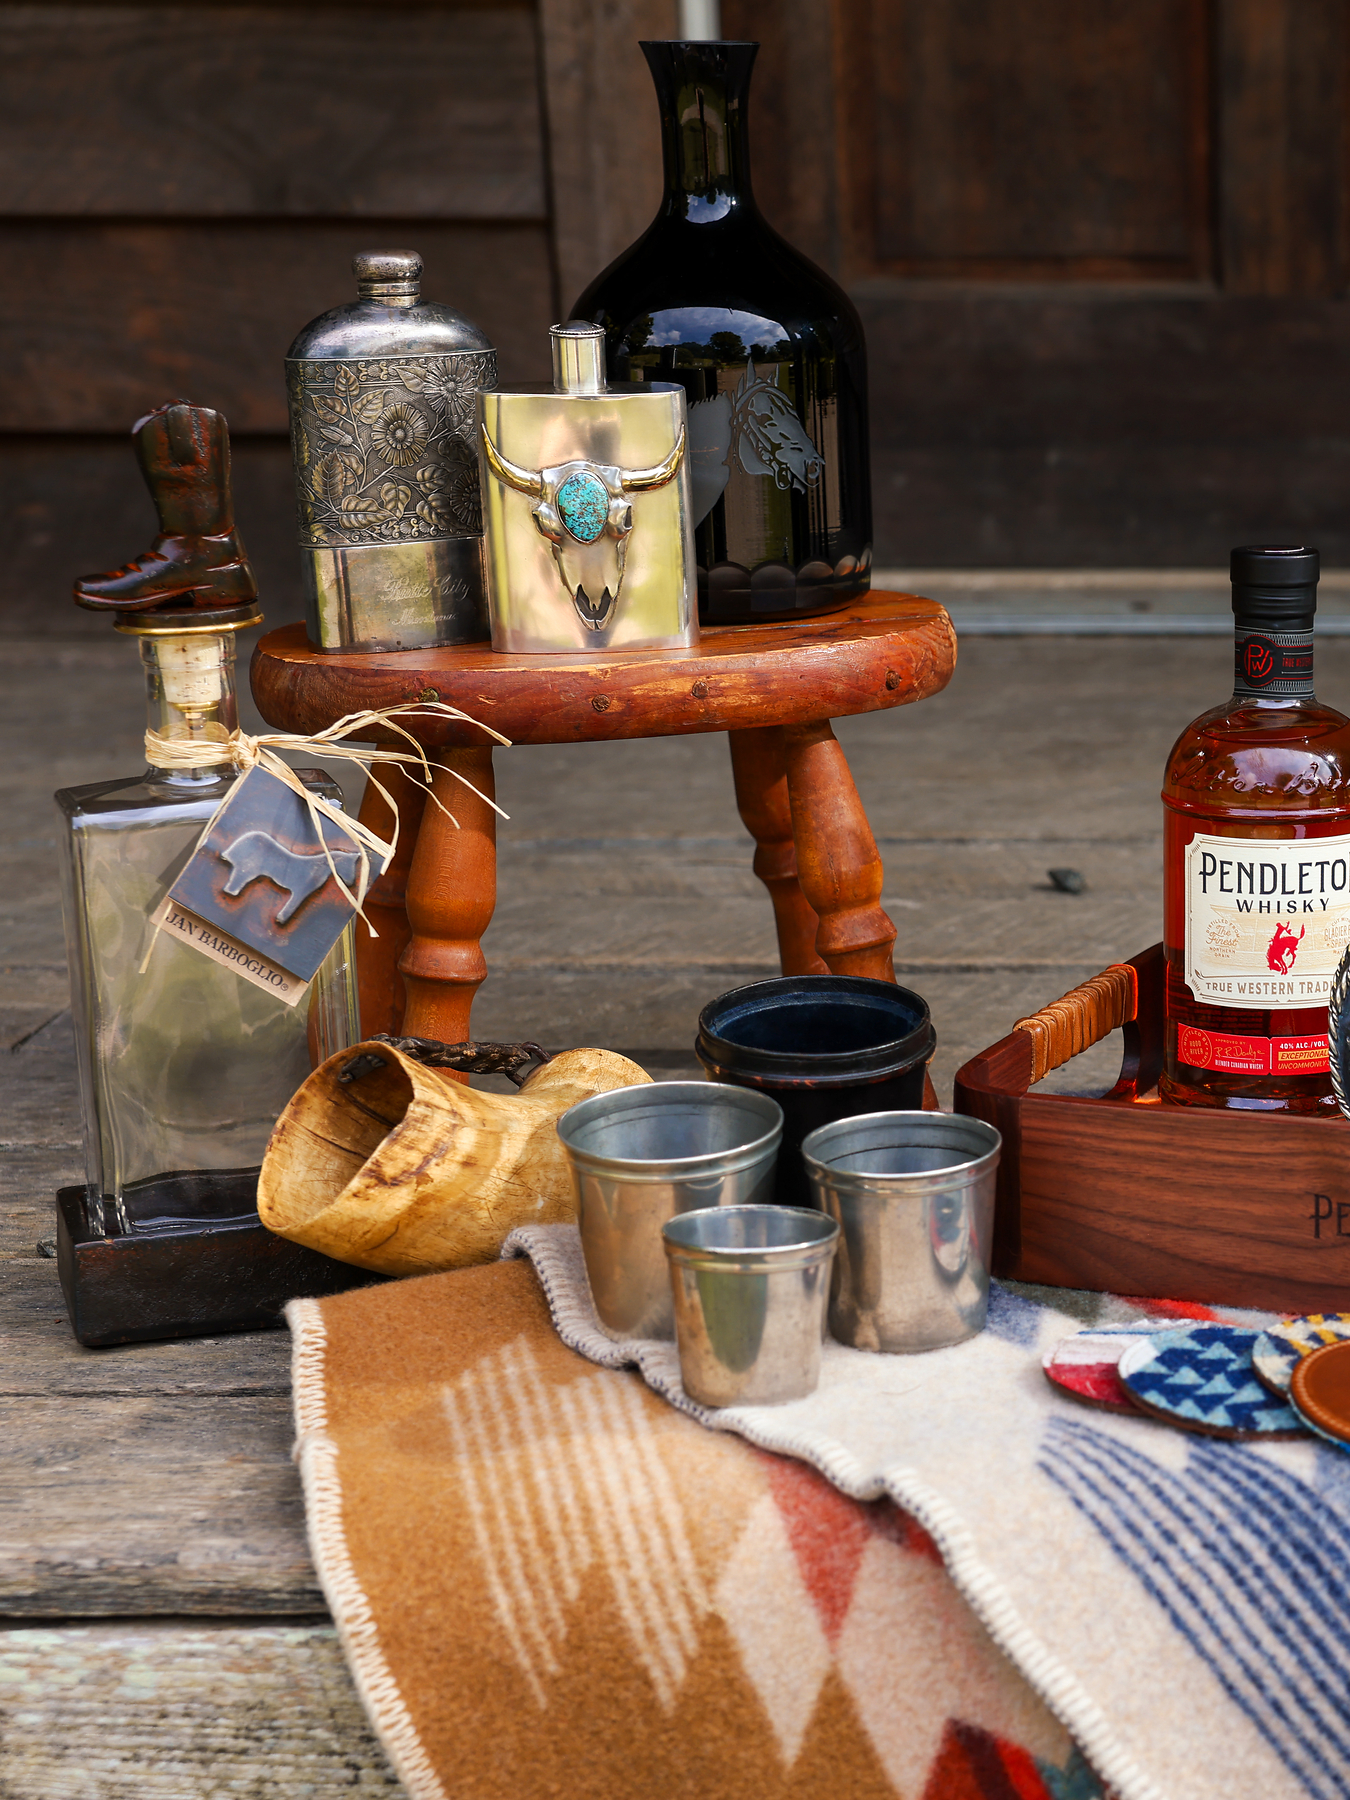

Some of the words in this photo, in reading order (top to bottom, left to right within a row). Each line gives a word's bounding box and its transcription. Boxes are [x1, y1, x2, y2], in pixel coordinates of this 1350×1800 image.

[1236, 898, 1330, 914] WHISKY
[165, 912, 199, 936] JAN
[1215, 924, 1232, 937] The
[1205, 931, 1239, 947] Finest
[1206, 982, 1232, 993] TRUE
[1237, 981, 1294, 995] WESTERN
[1299, 981, 1333, 994] TRADI
[1189, 1048, 1204, 1056] RIVER
[1280, 1042, 1294, 1050] 40%
[1281, 1049, 1330, 1060] EXCEPTIONAL
[1249, 1063, 1264, 1071] WHISKY
[1278, 1060, 1327, 1070] UNCOMMONLY
